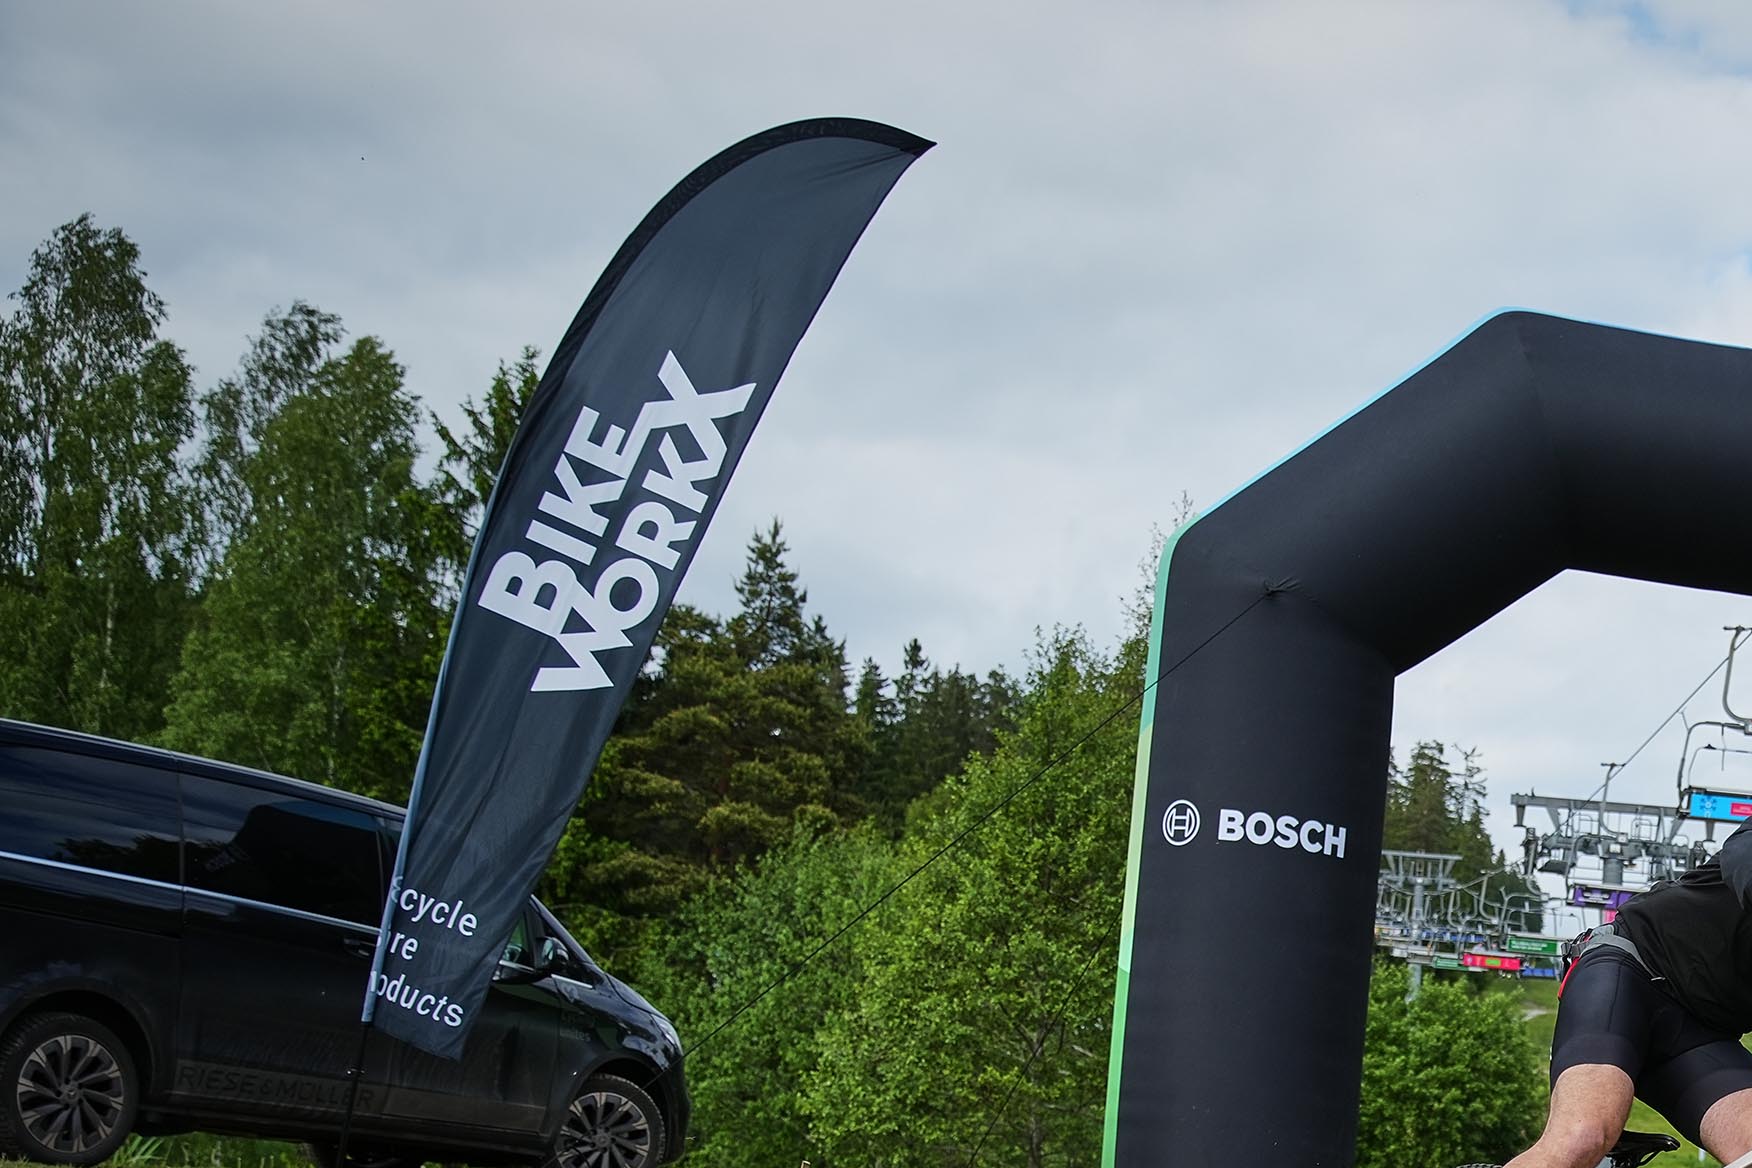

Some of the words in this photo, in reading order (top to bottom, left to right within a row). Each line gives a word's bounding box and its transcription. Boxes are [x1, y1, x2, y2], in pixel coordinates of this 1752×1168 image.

[477, 405, 632, 638] BIKE
[530, 350, 757, 692] WORKX
[1217, 808, 1347, 858] BOSCH
[386, 930, 419, 960] re
